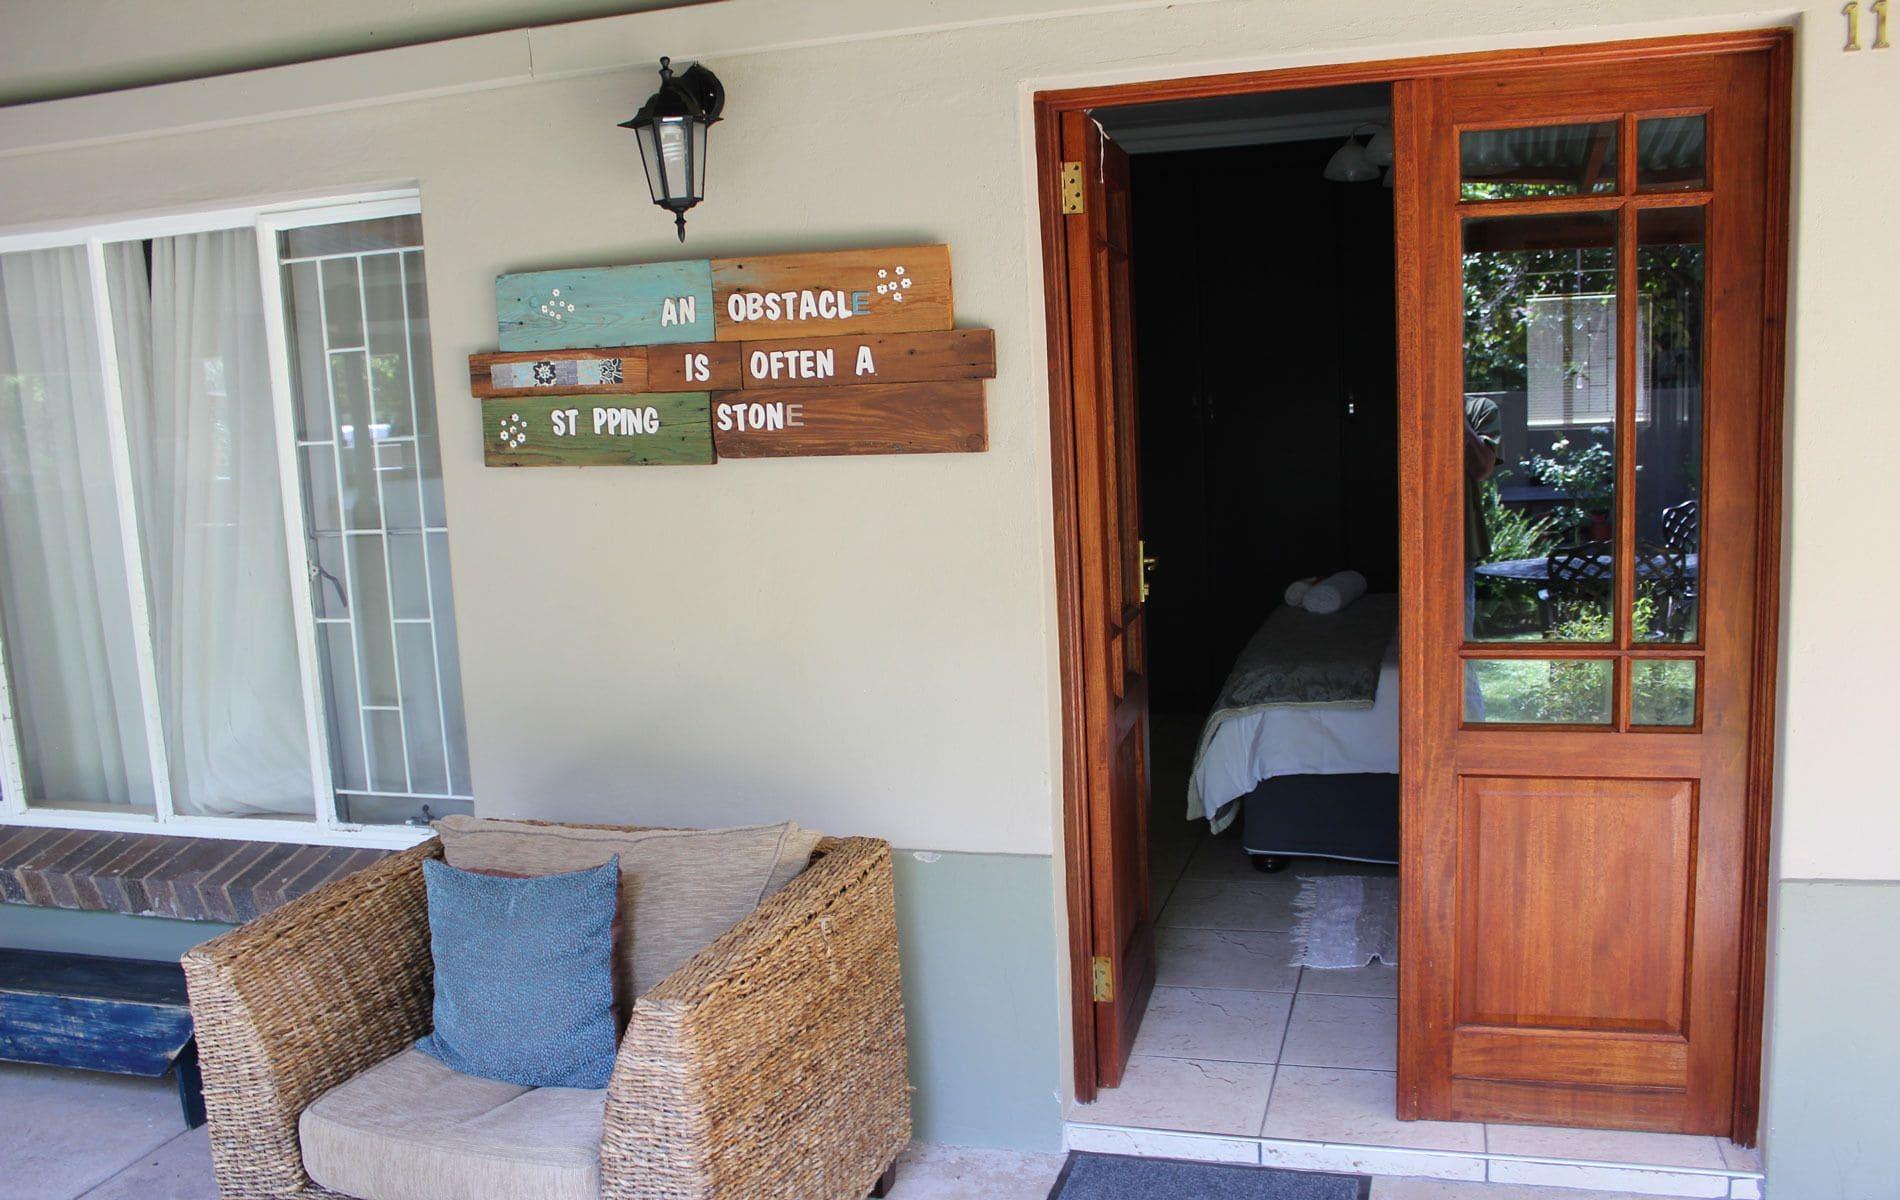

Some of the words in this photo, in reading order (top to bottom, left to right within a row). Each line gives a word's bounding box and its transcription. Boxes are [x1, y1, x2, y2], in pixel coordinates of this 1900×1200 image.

[1841, 0, 1890, 52] 11
[661, 296, 696, 327] AN
[727, 290, 871, 321] OBSTACLE
[685, 353, 710, 382] IS
[750, 348, 834, 379] OFTEN
[855, 345, 875, 376] A
[717, 402, 804, 432] STONE
